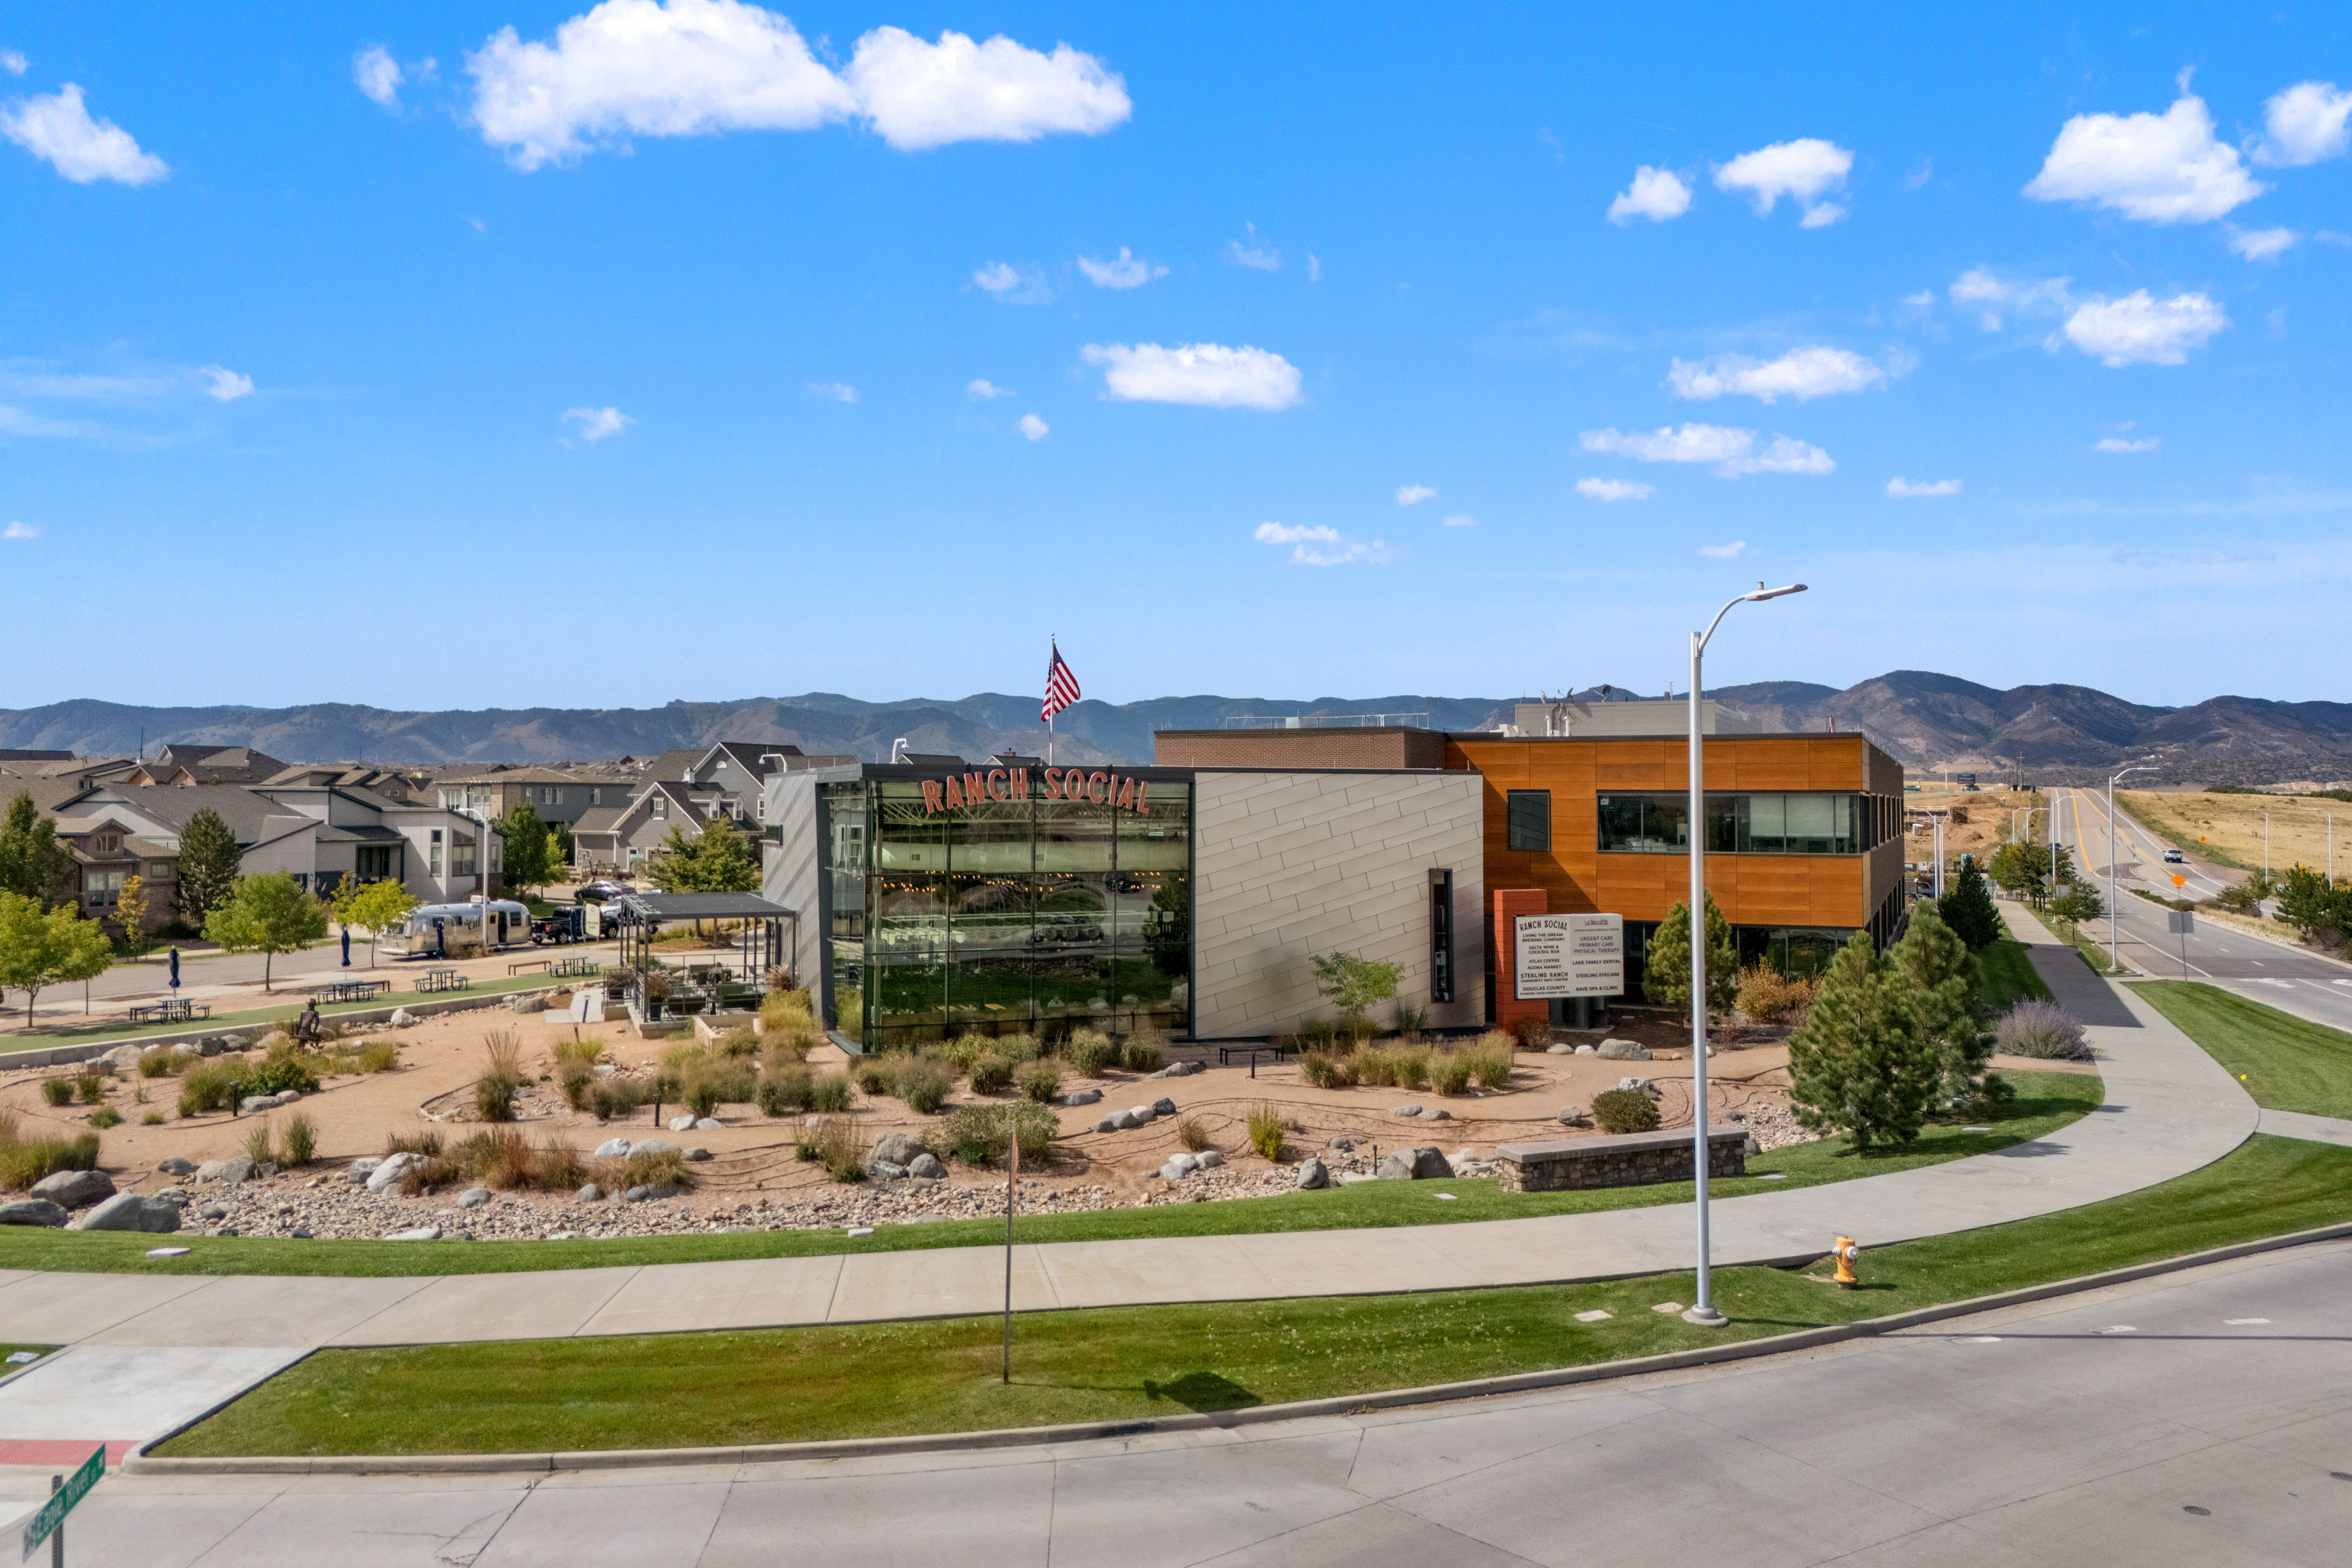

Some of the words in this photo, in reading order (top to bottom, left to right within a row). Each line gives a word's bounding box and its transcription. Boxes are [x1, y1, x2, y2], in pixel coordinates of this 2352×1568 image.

[922, 768, 1027, 814] RANCH
[1044, 767, 1150, 814] SOCIAL
[1519, 920, 1541, 931] RANCH
[1544, 920, 1567, 930] SOCIAL
[36, 1495, 64, 1540] Eagle
[66, 1466, 89, 1508] River
